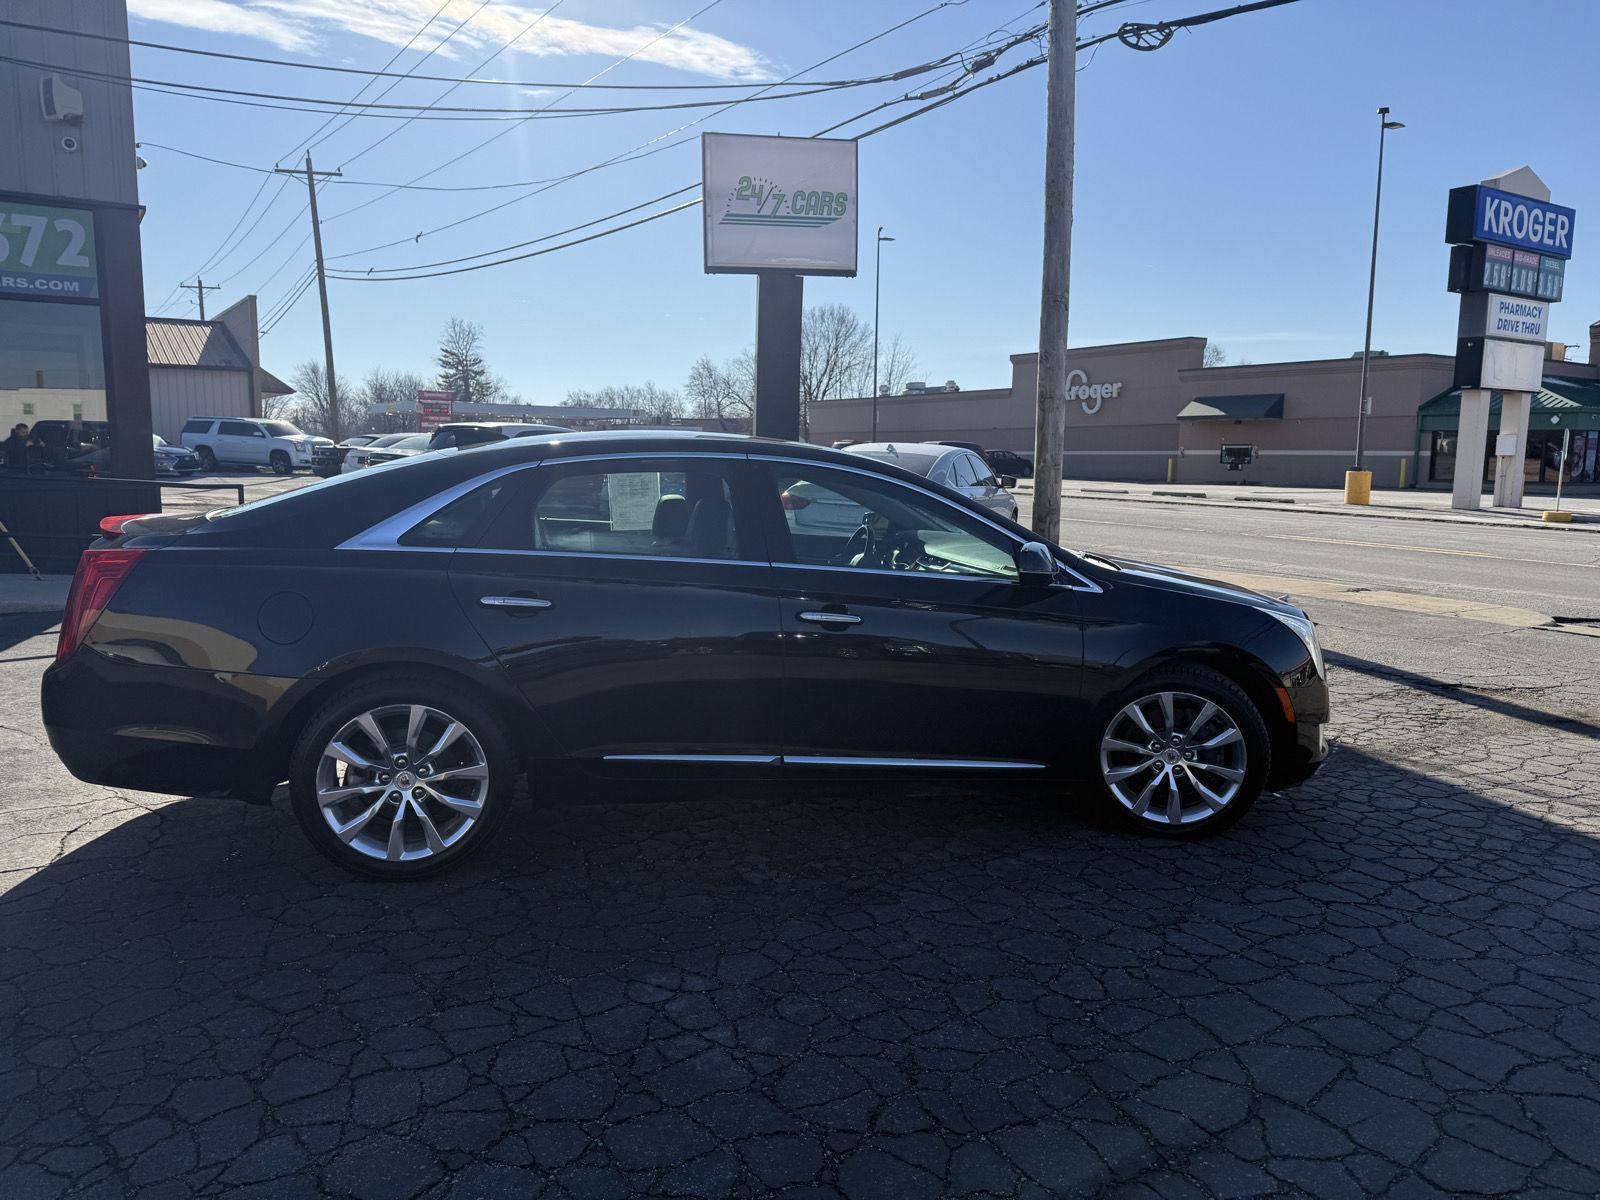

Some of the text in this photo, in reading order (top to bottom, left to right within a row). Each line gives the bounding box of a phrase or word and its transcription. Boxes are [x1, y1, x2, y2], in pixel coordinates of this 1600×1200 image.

[736, 176, 848, 217] 24/7 CARS
[1484, 196, 1569, 248] KROGER
[0, 276, 80, 292] RS.COM
[1499, 301, 1543, 319] PHARMACY
[1497, 318, 1541, 336] DRIVE THRU
